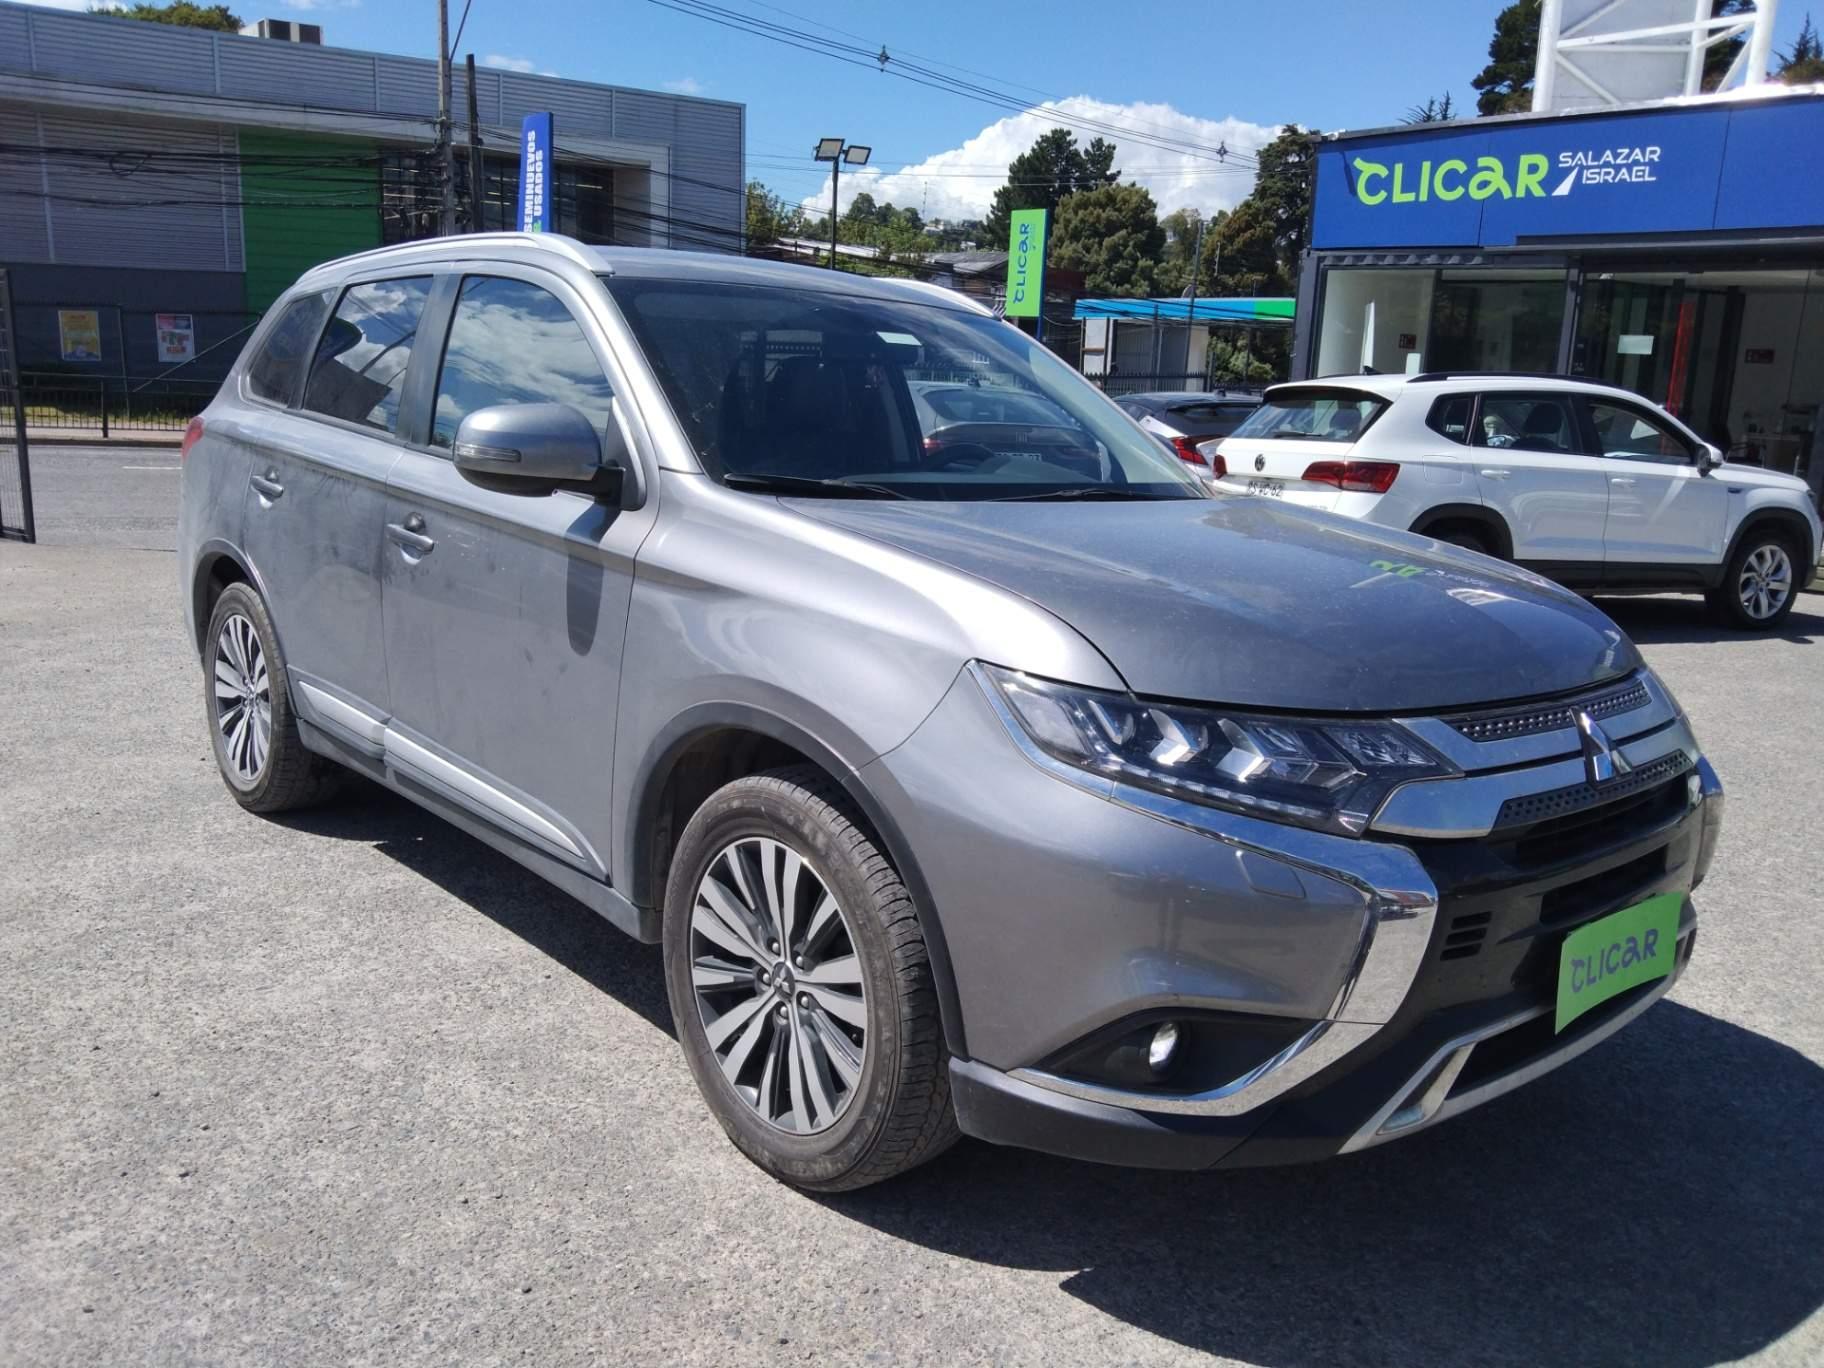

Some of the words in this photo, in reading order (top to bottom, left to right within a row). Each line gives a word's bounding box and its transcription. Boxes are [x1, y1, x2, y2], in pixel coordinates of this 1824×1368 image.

[1558, 146, 1661, 168] SALAZAR
[1582, 165, 1657, 185] ISRAEL
[523, 130, 536, 233] SEMINUEVOS
[533, 149, 543, 217] USADOS
